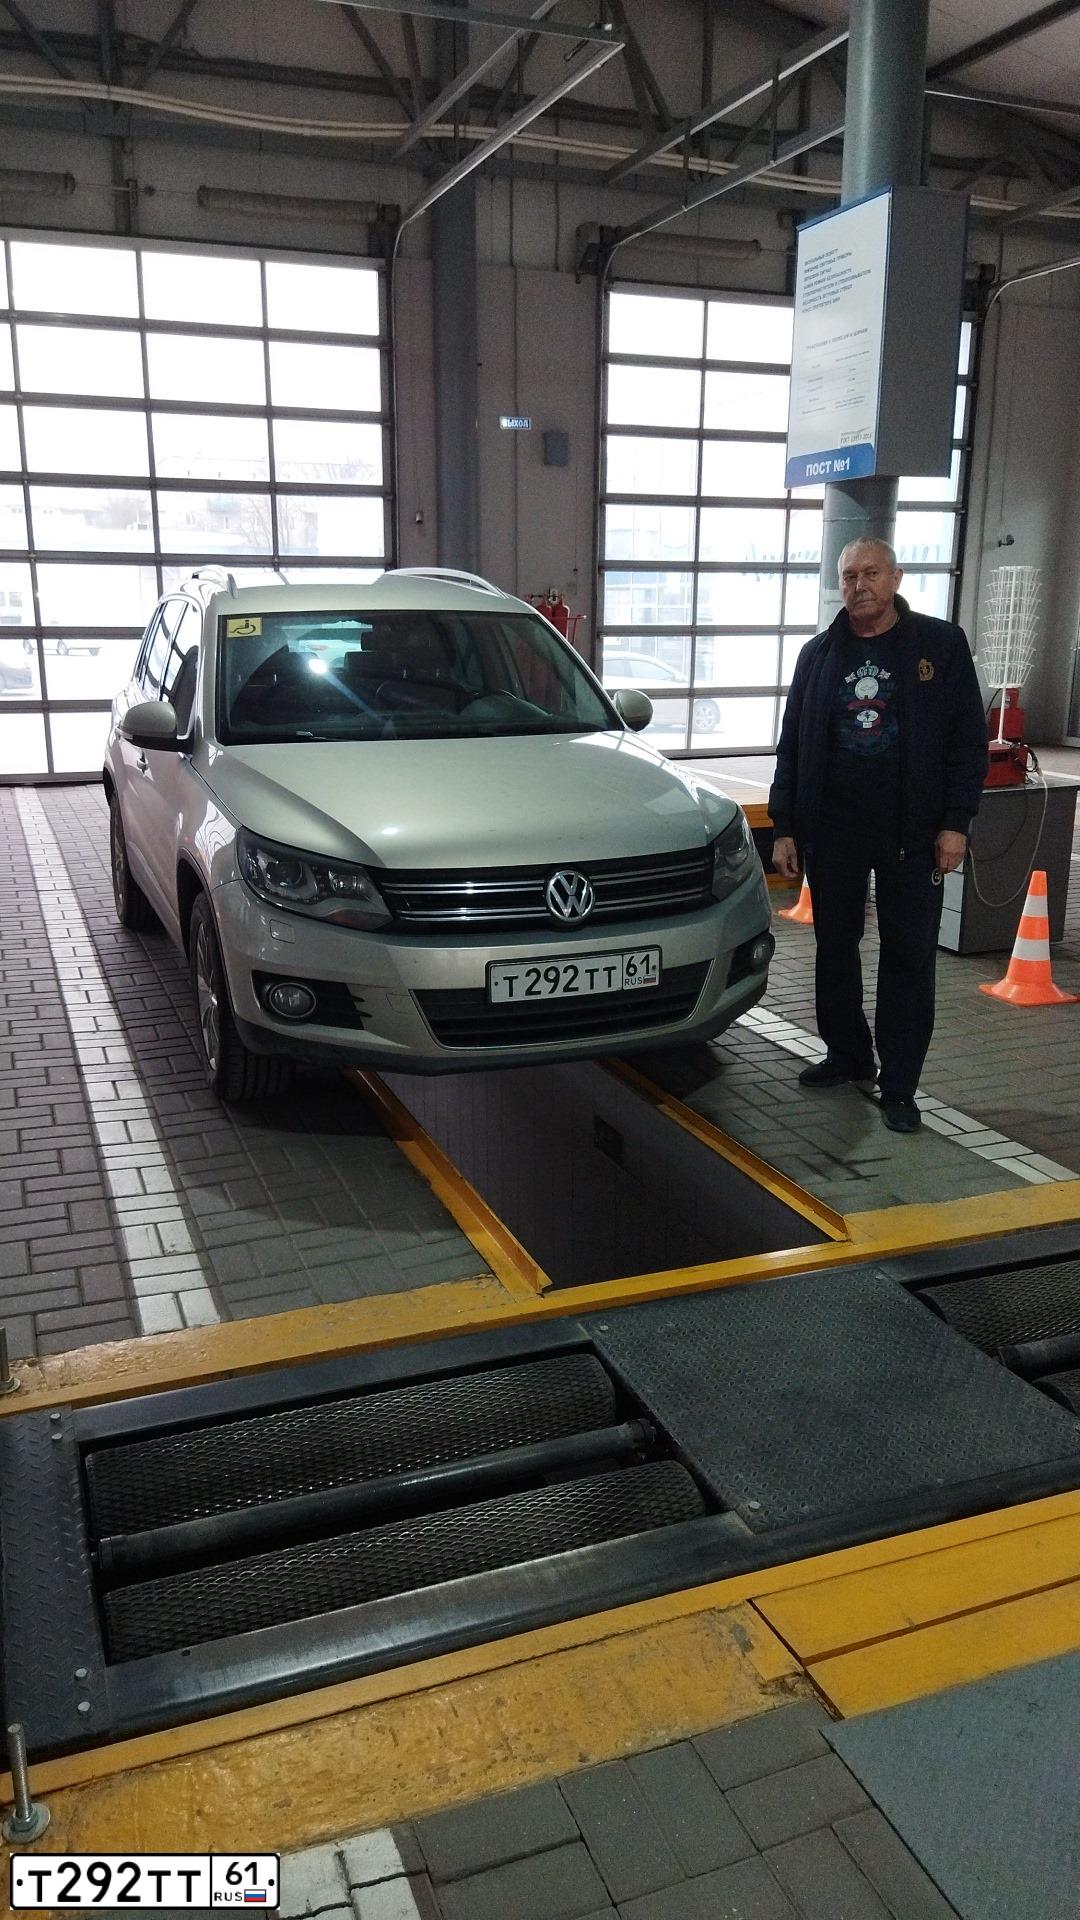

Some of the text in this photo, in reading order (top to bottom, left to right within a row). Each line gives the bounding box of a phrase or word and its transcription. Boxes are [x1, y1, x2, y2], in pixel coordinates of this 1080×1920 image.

[806, 457, 851, 477] ПОСТ №1
[625, 953, 652, 977] 61
[624, 975, 643, 986] RUS
